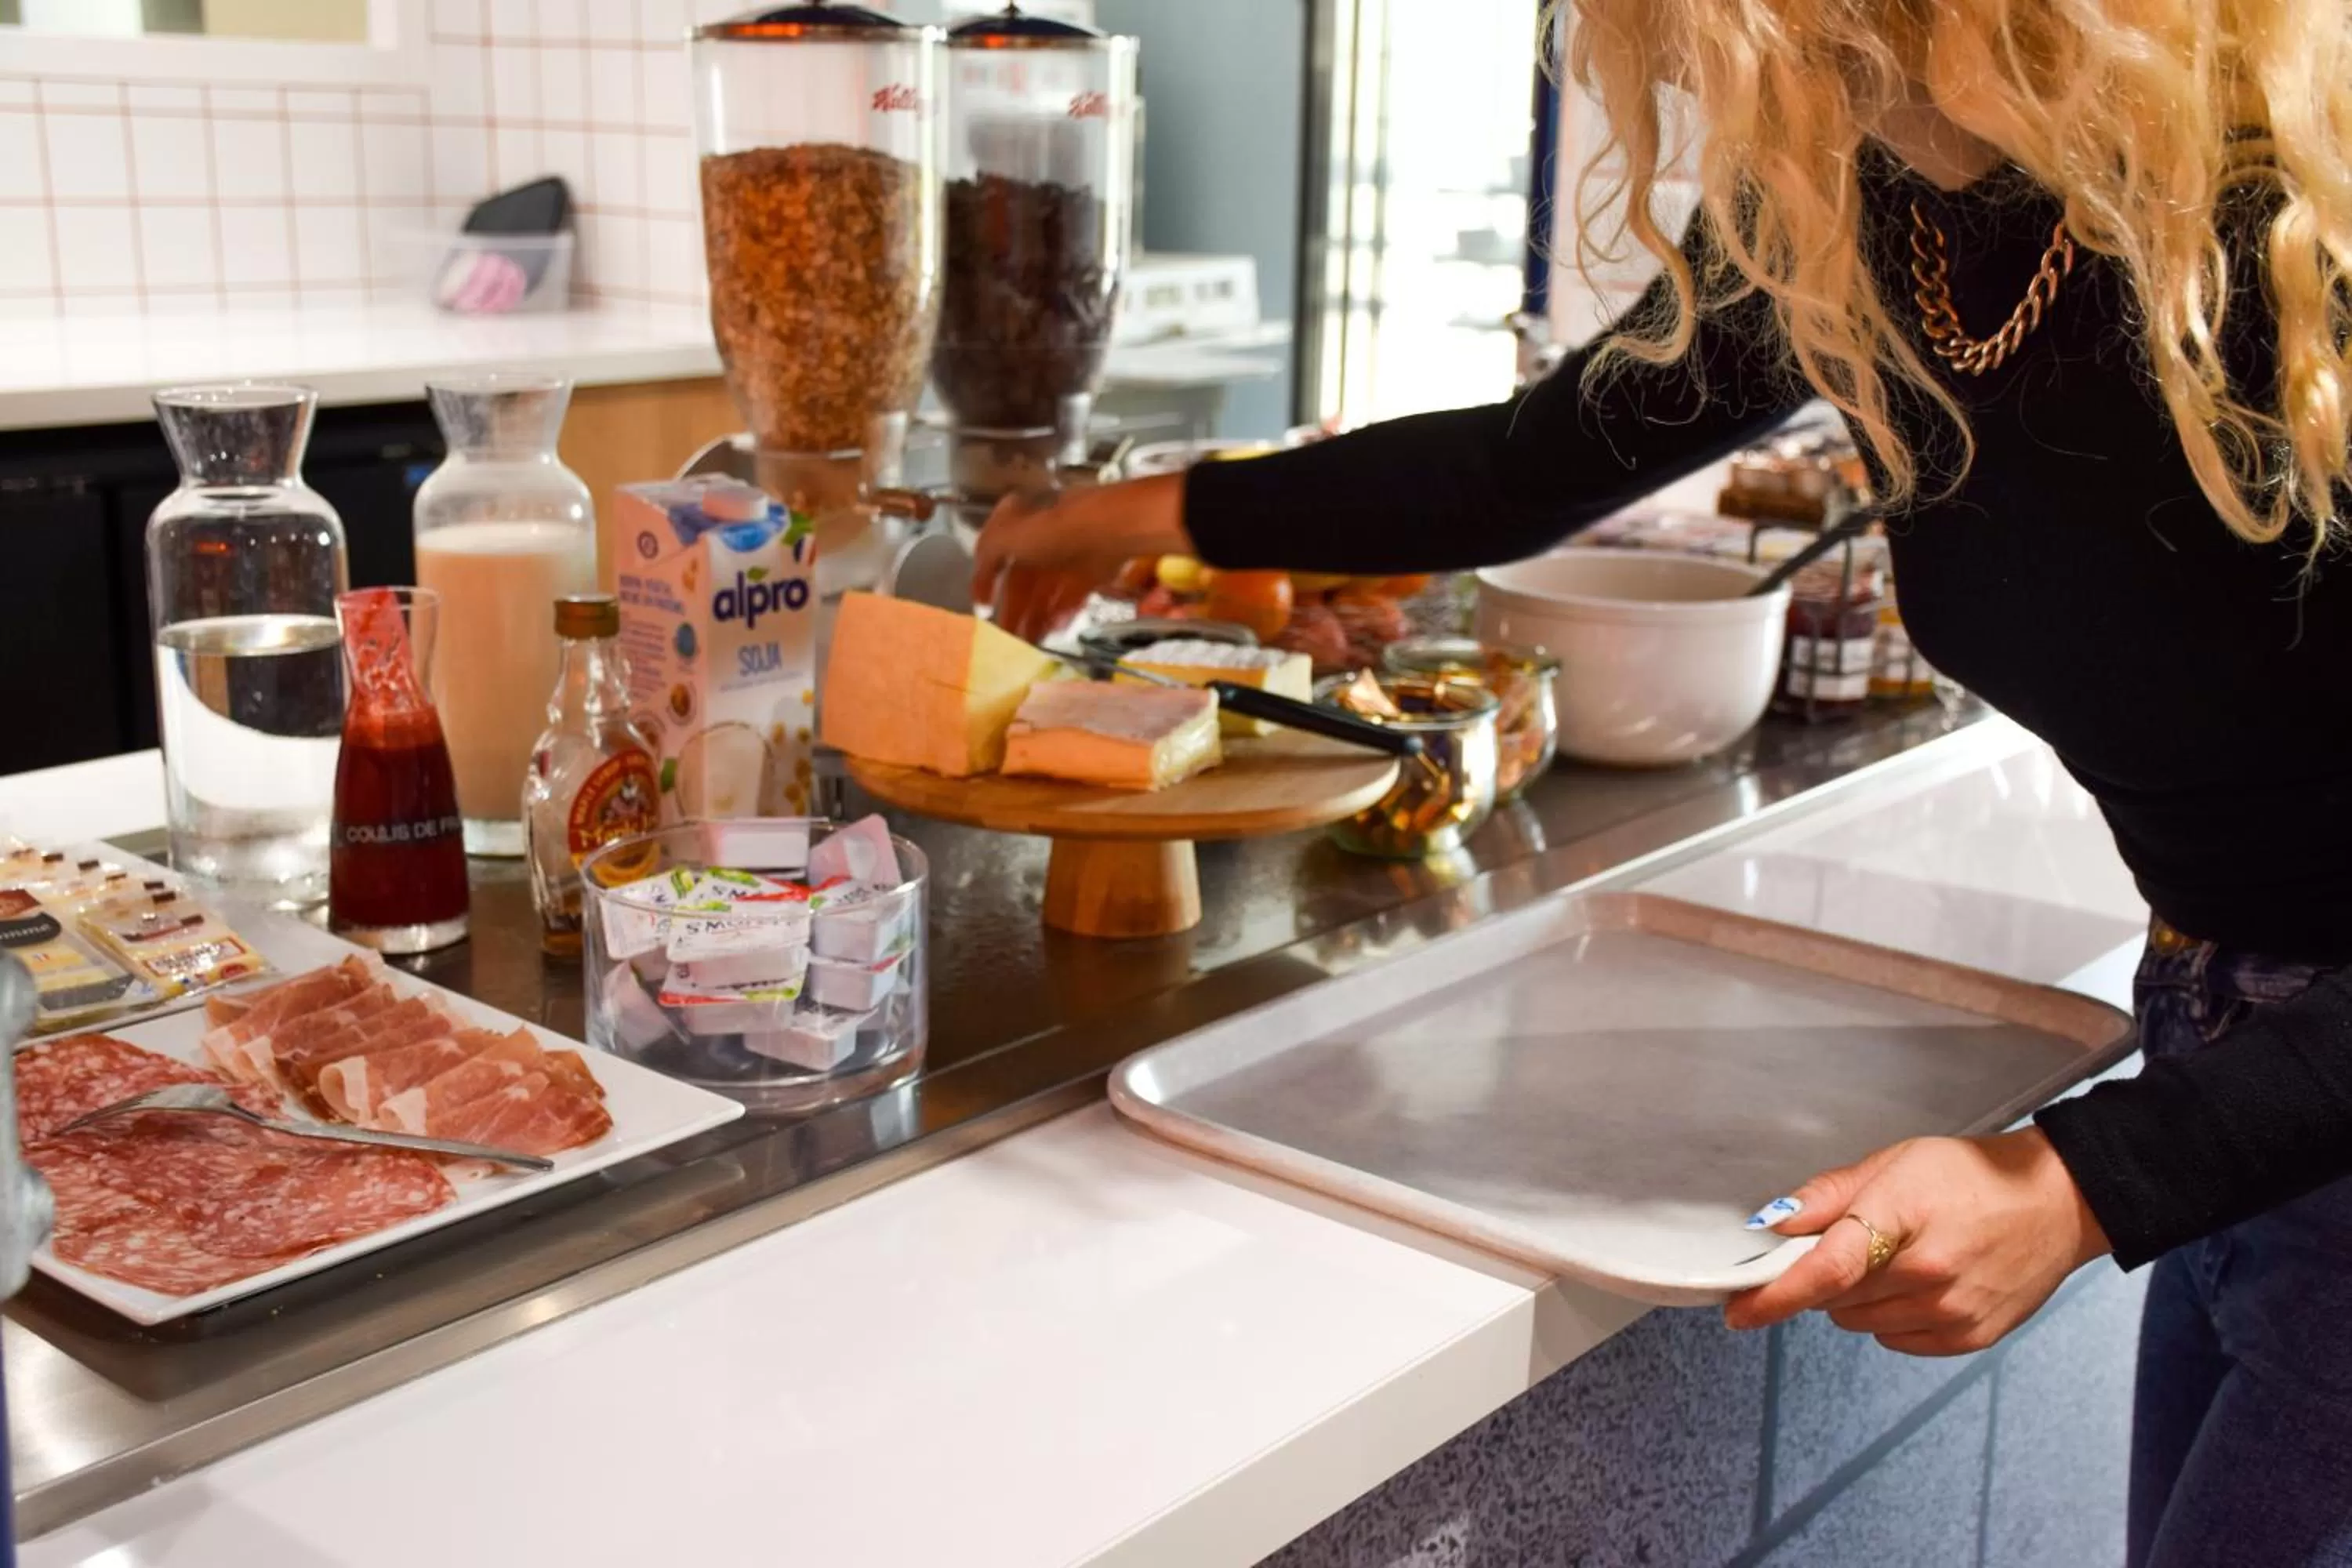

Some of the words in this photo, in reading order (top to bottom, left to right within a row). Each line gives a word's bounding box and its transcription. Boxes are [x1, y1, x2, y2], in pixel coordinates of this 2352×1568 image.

[713, 570, 809, 630] alpro
[738, 641, 782, 677] SOJA
[413, 819, 438, 840] DE
